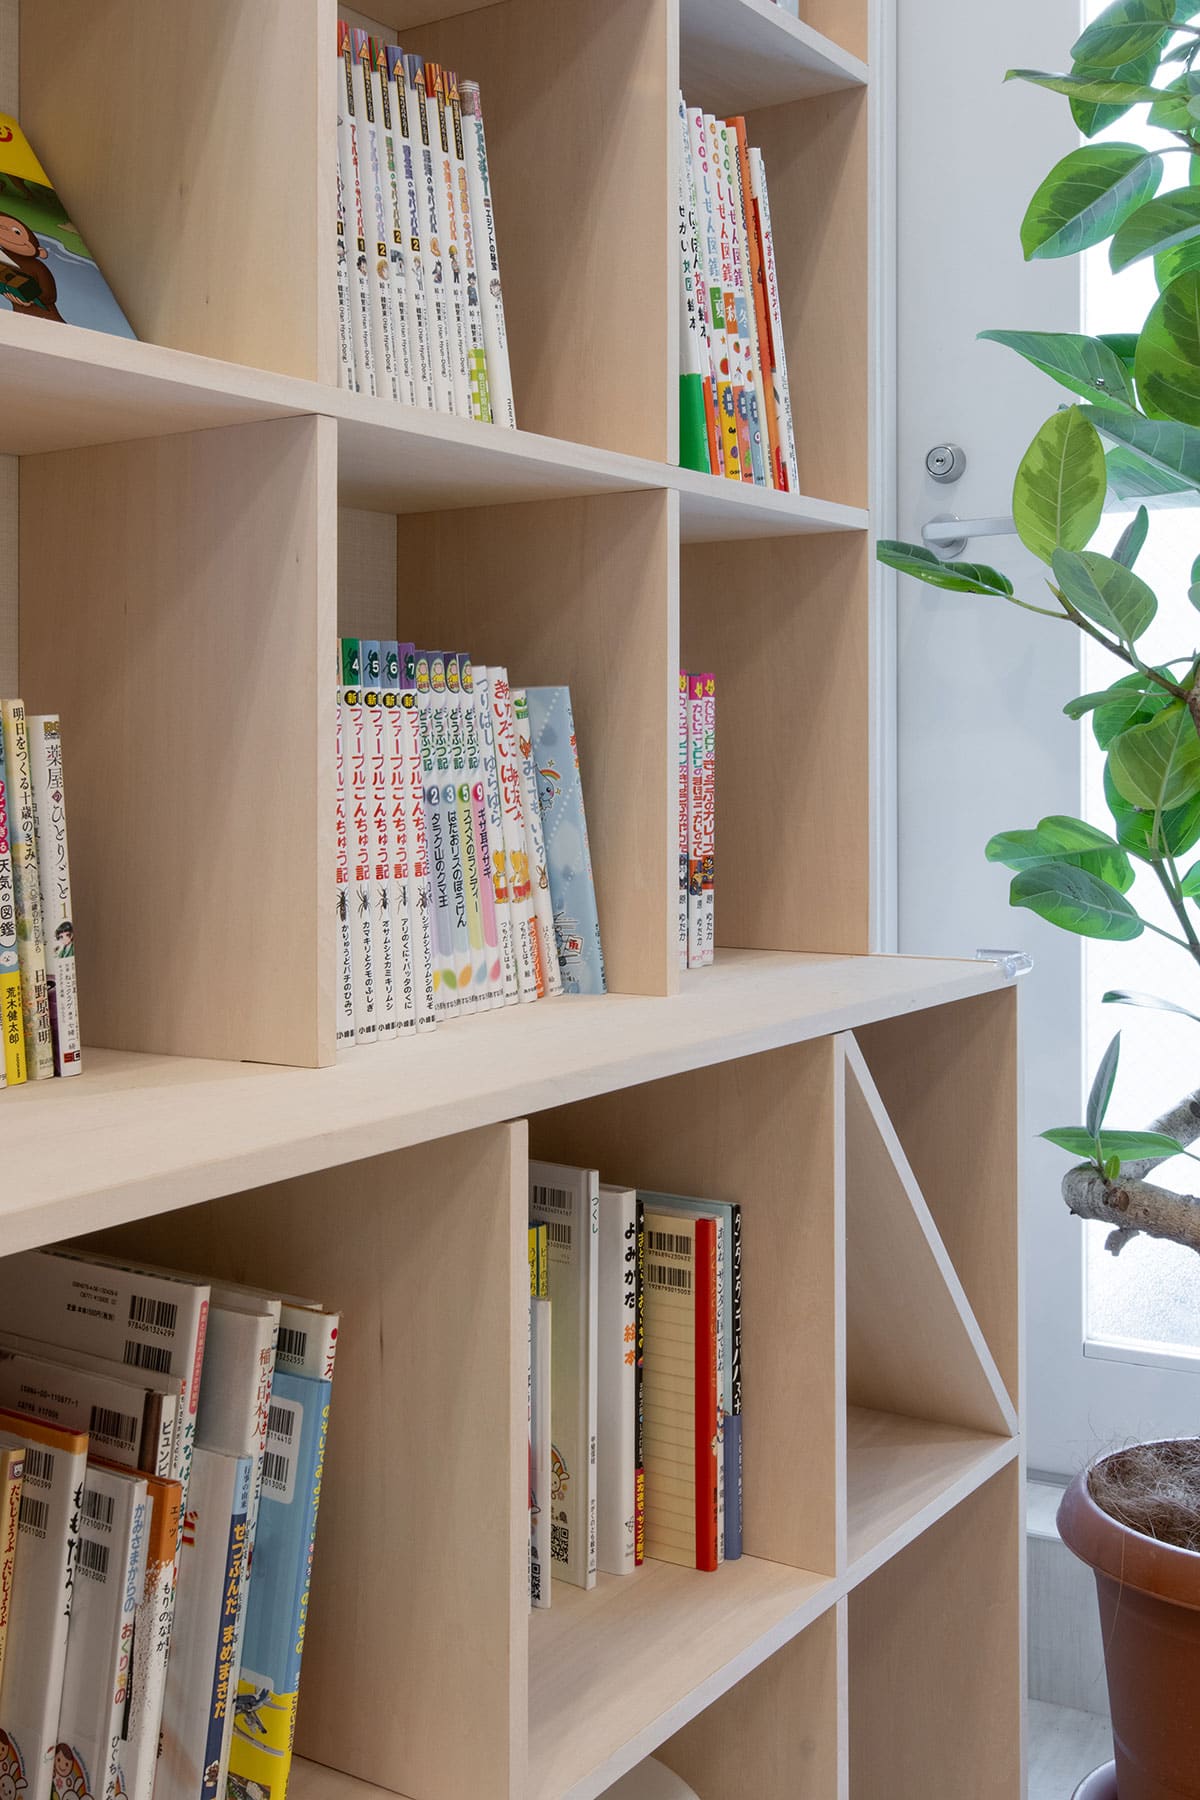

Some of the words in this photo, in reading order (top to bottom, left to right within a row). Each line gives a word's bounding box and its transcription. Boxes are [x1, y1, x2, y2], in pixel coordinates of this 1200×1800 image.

[352, 660, 359, 671] 4
[372, 661, 380, 673] 5
[390, 663, 398, 674] 6
[408, 663, 415, 675] 7
[13, 707, 37, 871] 明日をつくる十歳のきみへ
[45, 744, 68, 900] 薬屋のひとりごと
[350, 708, 370, 881] ファーブルこんちゅう記
[369, 710, 389, 880] ファーブルこんちゅう記
[388, 710, 408, 880] ファーブルこんちゅう記
[407, 711, 427, 878] ファーブルこんちゅう記
[431, 788, 439, 803] 2
[447, 786, 454, 800] 3
[462, 785, 469, 799] 5
[477, 783, 483, 796] 9
[0, 859, 15, 937] 天気の図鑑
[431, 813, 449, 908] タラク山のクマ王
[60, 903, 67, 918] 1
[341, 924, 352, 1016] かりゅうどバチのひみつ
[362, 921, 374, 1013] カマキリとクモのふしぎ
[382, 920, 393, 1011] オサムシとカミキリムシ
[6, 987, 20, 1045] 荒木健太郎
[34, 969, 51, 1044] 日野原重明
[127, 1320, 175, 1338] 9784061324299
[252, 1348, 272, 1437] 稲と日本人
[5, 1485, 20, 1553] だいじょうぶ
[169, 1506, 178, 1537] エッツ
[225, 1524, 247, 1615] せつぶんだ
[156, 1583, 171, 1652] もりのなか
[114, 1623, 132, 1704] おくりもの
[214, 1624, 234, 1718] まめまきだ
[109, 1735, 120, 1774] ひぐち
